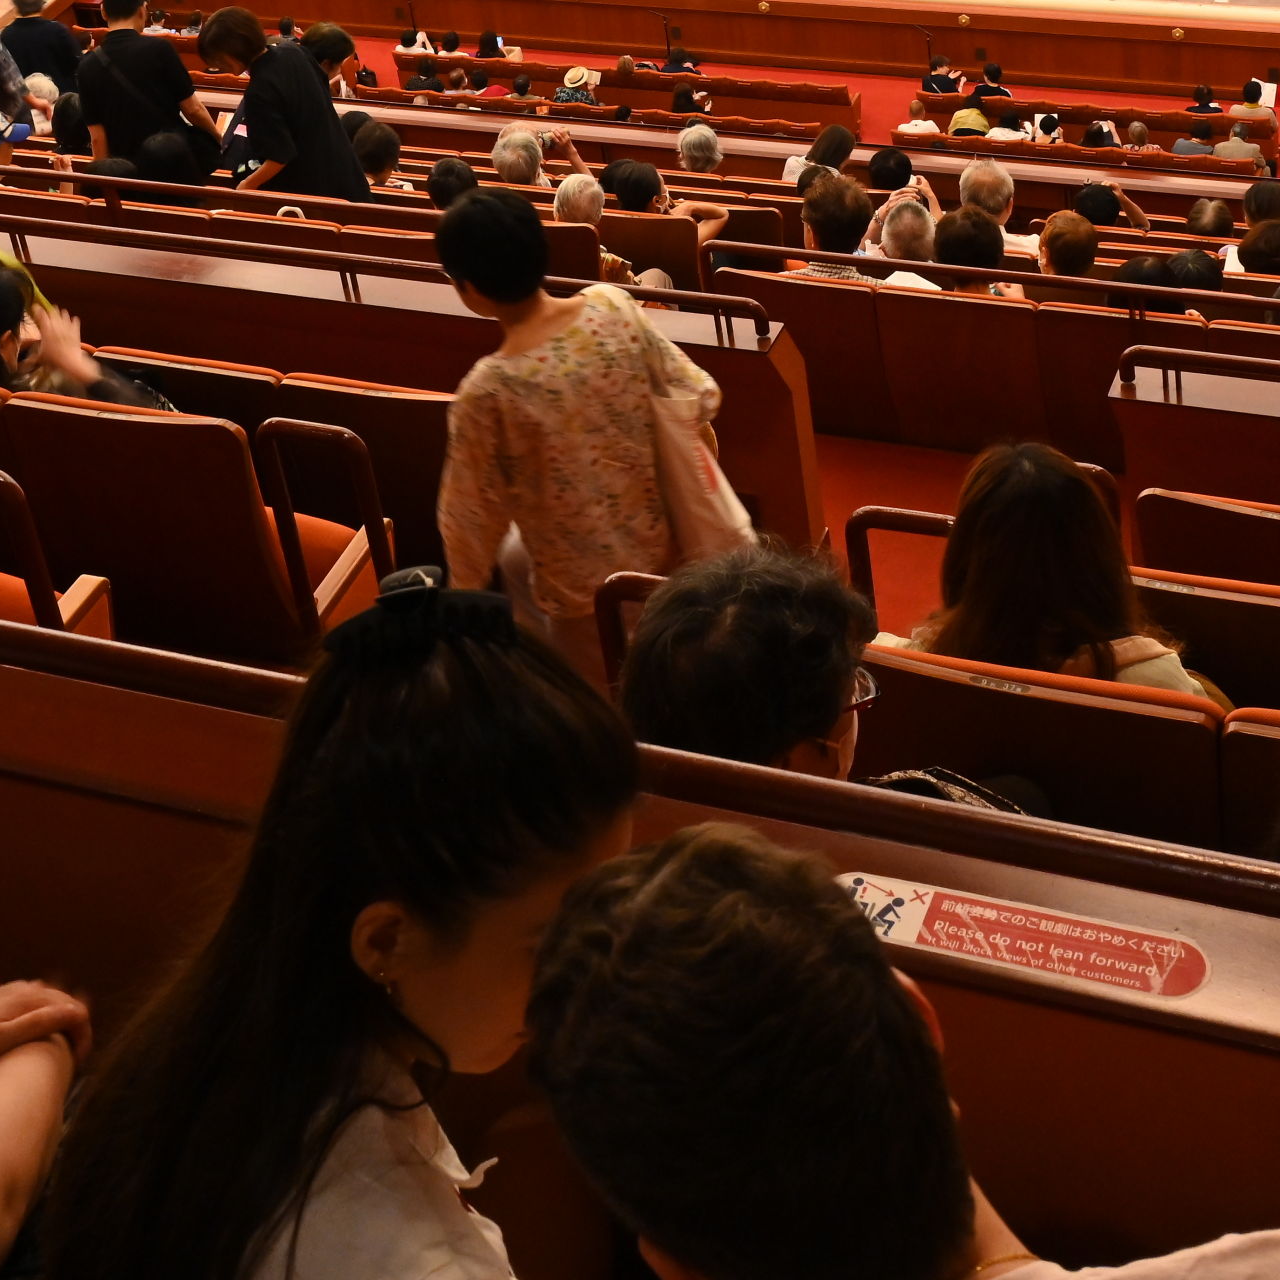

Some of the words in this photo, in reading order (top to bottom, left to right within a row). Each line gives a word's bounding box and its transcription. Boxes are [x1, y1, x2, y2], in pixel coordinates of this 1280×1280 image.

[933, 920, 984, 941] Please
[989, 932, 1010, 946] do
[1016, 938, 1044, 953] not
[1049, 941, 1083, 961] lean
[1090, 951, 1159, 977] forward.
[939, 937, 959, 949] will
[963, 942, 992, 957] block
[997, 949, 1027, 964] views
[1032, 956, 1045, 967] of
[1046, 959, 1076, 974] other
[1081, 968, 1143, 989] customers.
